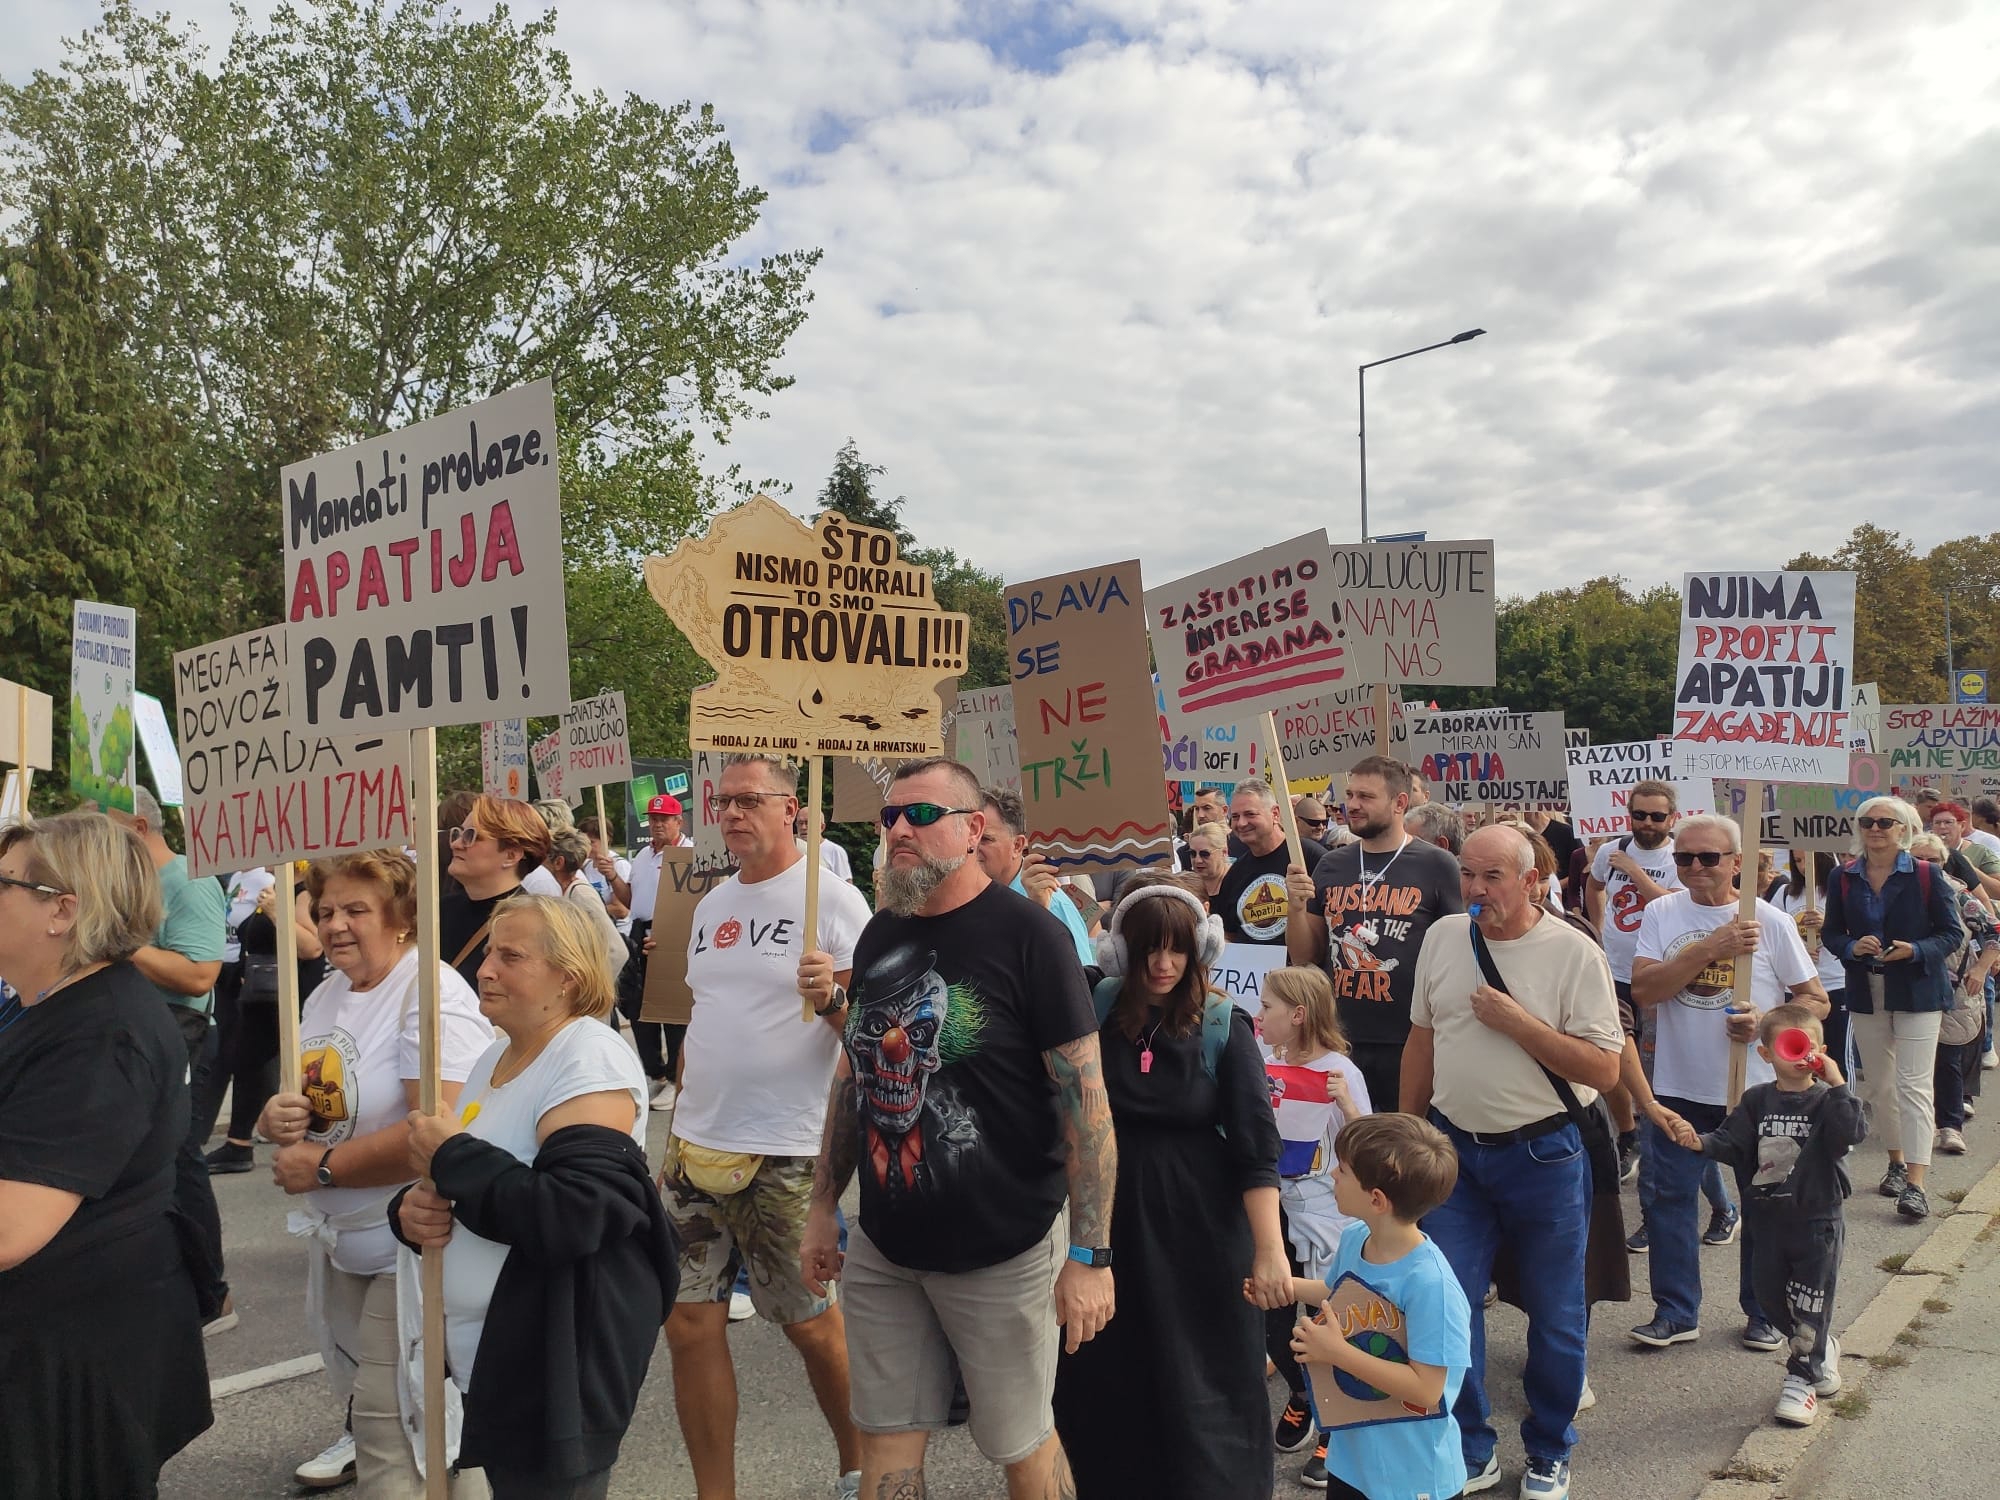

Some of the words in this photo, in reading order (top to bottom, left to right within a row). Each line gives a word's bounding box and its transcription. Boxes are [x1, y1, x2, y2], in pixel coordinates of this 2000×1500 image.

[290, 450, 408, 549] Mandati
[422, 421, 549, 529] prolaze,
[821, 516, 891, 566] ŠTO
[290, 499, 524, 622] APATIJA
[736, 551, 818, 587] NISMO
[828, 563, 925, 598] POKRALI
[794, 589, 821, 607] TO
[829, 593, 874, 612] SMO
[1008, 575, 1130, 635] DRAVA
[1160, 559, 1319, 629] ZAŠTITIMO
[1688, 575, 1823, 621] NJIMA
[722, 603, 963, 669] OTROVALI!!!
[1185, 589, 1309, 657] INTERESE
[1346, 598, 1440, 639] NAMA
[1014, 641, 1060, 680] SE
[1385, 642, 1442, 678] NAS
[1693, 625, 1837, 664] PROFIT
[304, 605, 531, 724] PAMTI!
[1677, 660, 1845, 711] APATIJI
[1040, 682, 1107, 735] NE
[1413, 713, 1535, 735] ZABORAVITE
[1886, 709, 1933, 730] STOP
[569, 717, 625, 746] ODLUČNO
[712, 734, 750, 748] HODAJ
[754, 736, 769, 748] ZA
[772, 736, 798, 749] LIKU
[817, 738, 853, 751] HODAJ
[856, 739, 870, 752] ZA
[873, 740, 926, 754] HRVATSKU
[1442, 735, 1497, 751] MIRAN
[1508, 732, 1541, 750] SAN
[1672, 711, 1850, 749] ZAGAĐENJE
[1021, 738, 1111, 801] TRŽI
[1280, 741, 1304, 763] OJI
[1309, 741, 1329, 757] GA
[1421, 752, 1505, 782] APATIJA
[1567, 743, 1651, 766] RAZVOJ
[1926, 749, 1954, 769] NE
[1445, 782, 1472, 801] NE
[190, 764, 409, 876] KATAKLIZMA
[1794, 815, 1854, 838] NITRA
[1249, 905, 1282, 919] Apatija
[1326, 883, 1422, 917] HUSBAND
[1384, 918, 1413, 942] THE
[1209, 967, 1267, 997] ZRA
[1333, 970, 1394, 1002] YEAR
